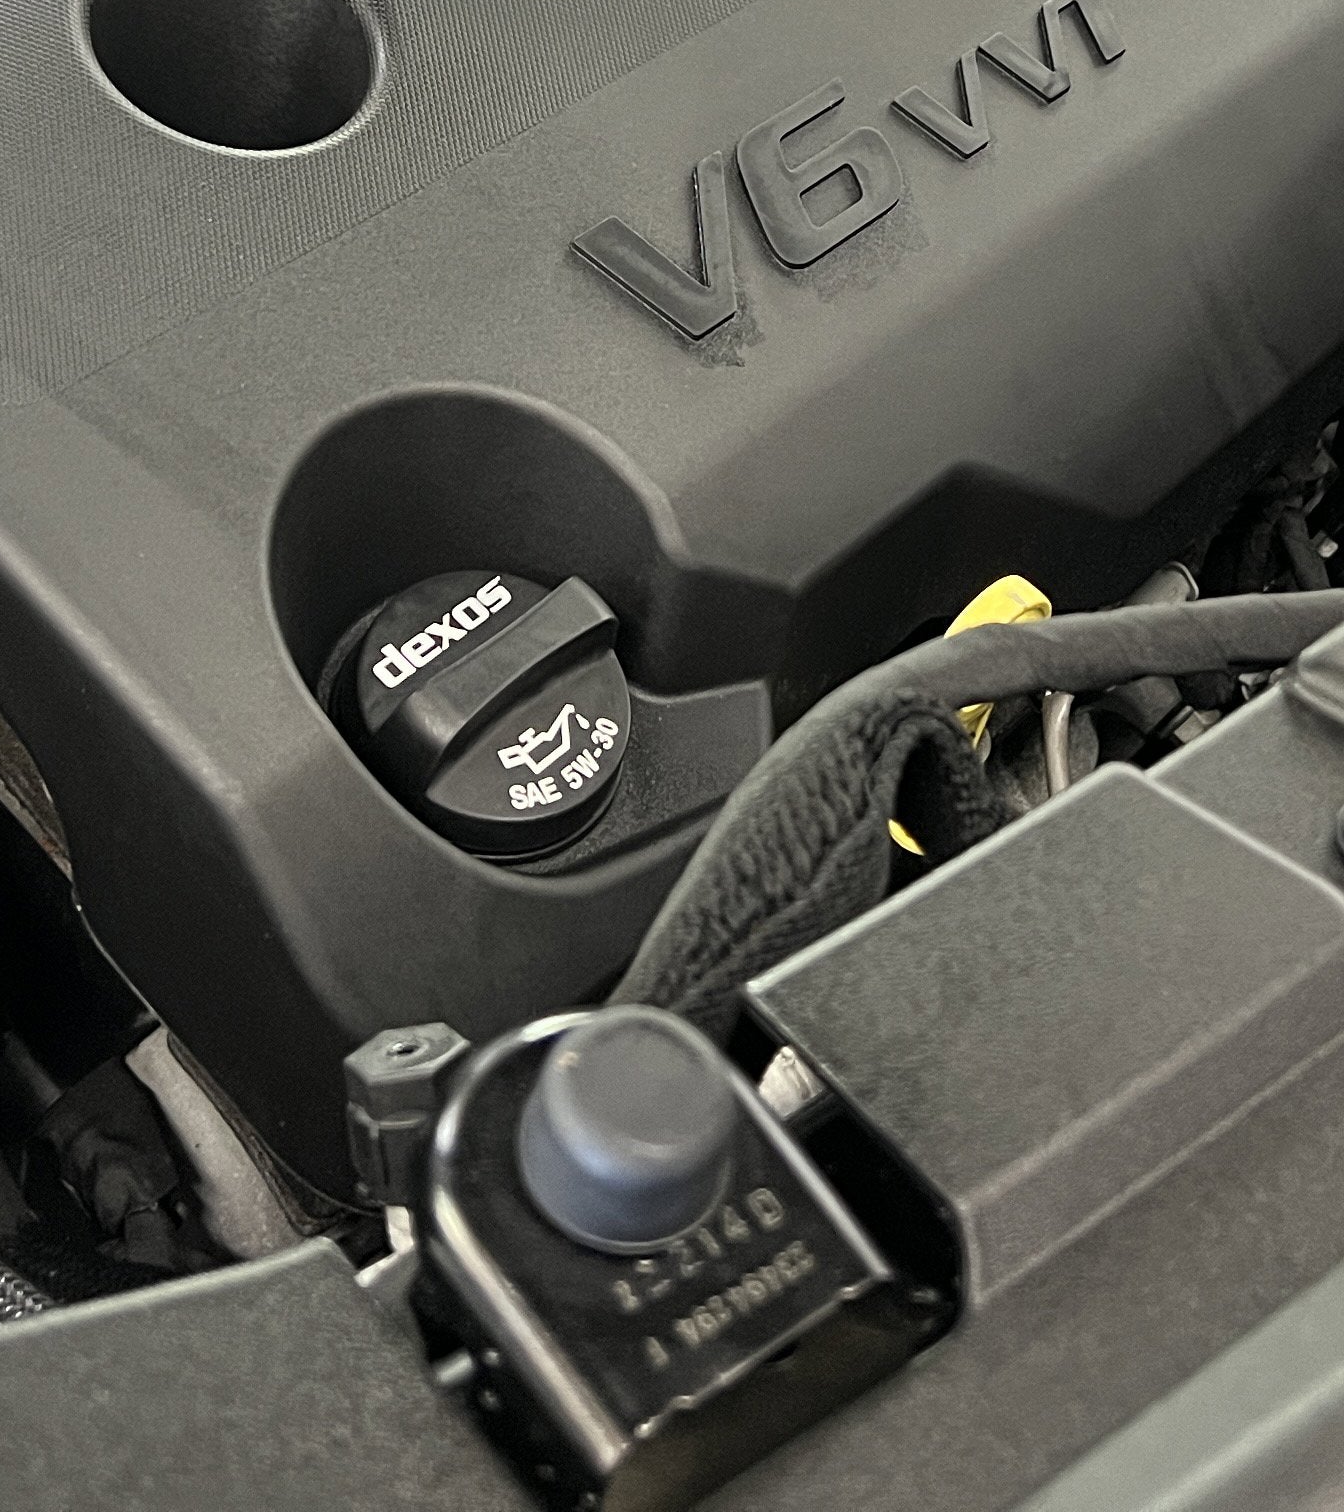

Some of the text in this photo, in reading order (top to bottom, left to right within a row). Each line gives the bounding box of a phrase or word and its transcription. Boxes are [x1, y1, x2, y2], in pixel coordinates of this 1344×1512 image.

[570, 78, 903, 341] V6
[372, 575, 513, 689] dexos
[508, 717, 619, 810] SAE 5W-30
